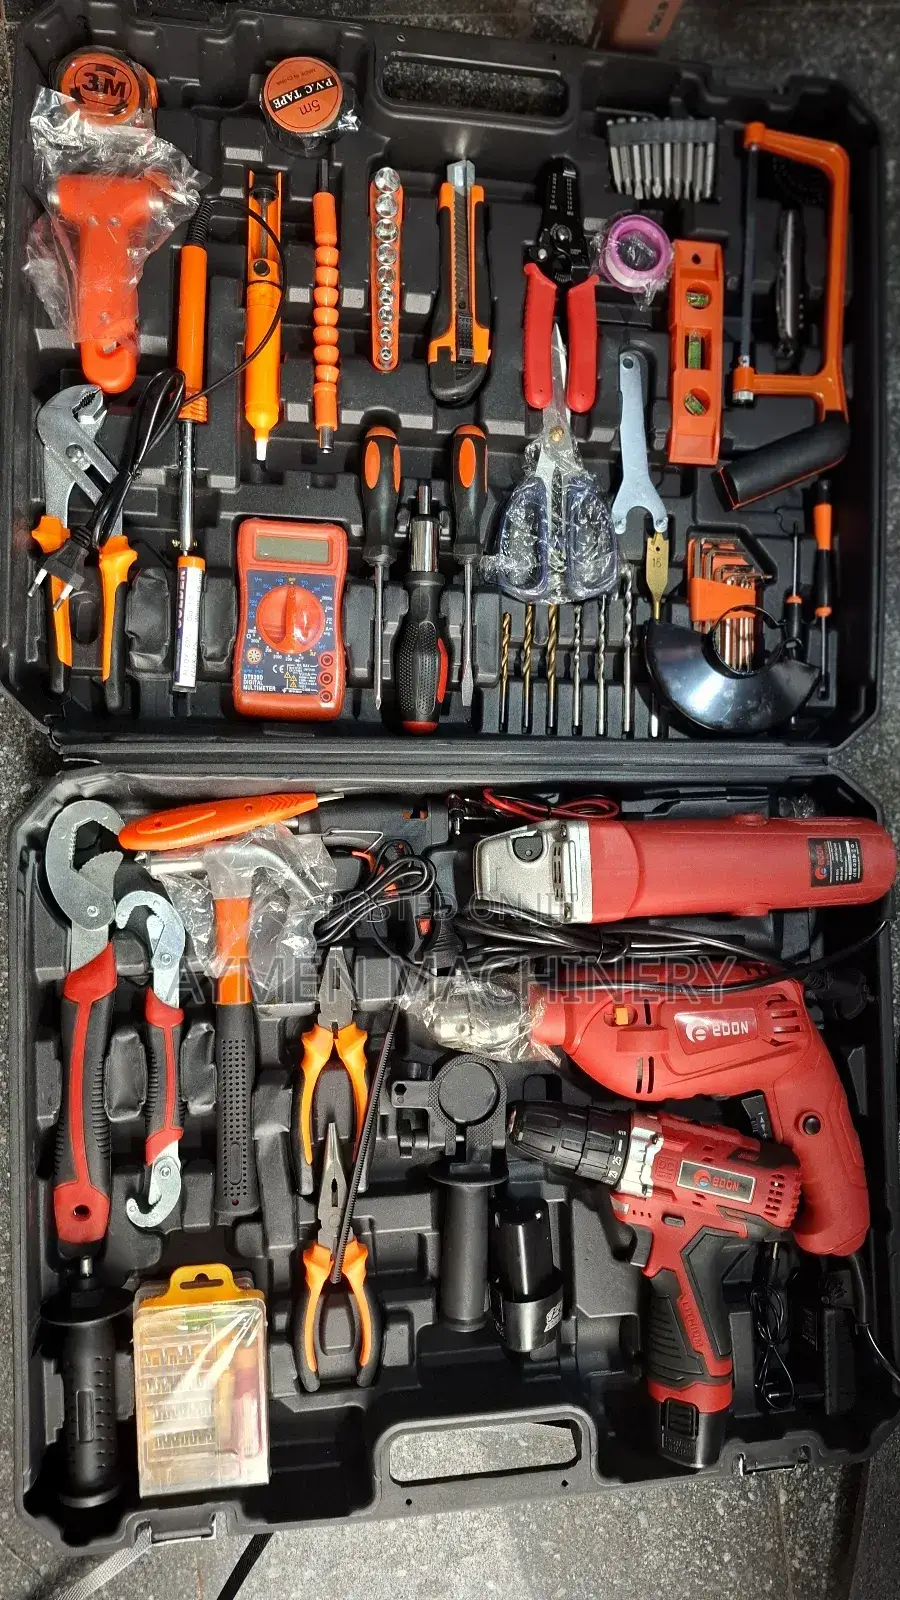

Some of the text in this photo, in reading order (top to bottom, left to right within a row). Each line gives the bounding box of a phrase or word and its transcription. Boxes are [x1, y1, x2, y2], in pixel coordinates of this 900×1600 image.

[81, 72, 126, 99] 3M
[272, 77, 334, 109] P.V.C TAPE
[299, 99, 321, 115] 5m
[652, 557, 662, 568] 16
